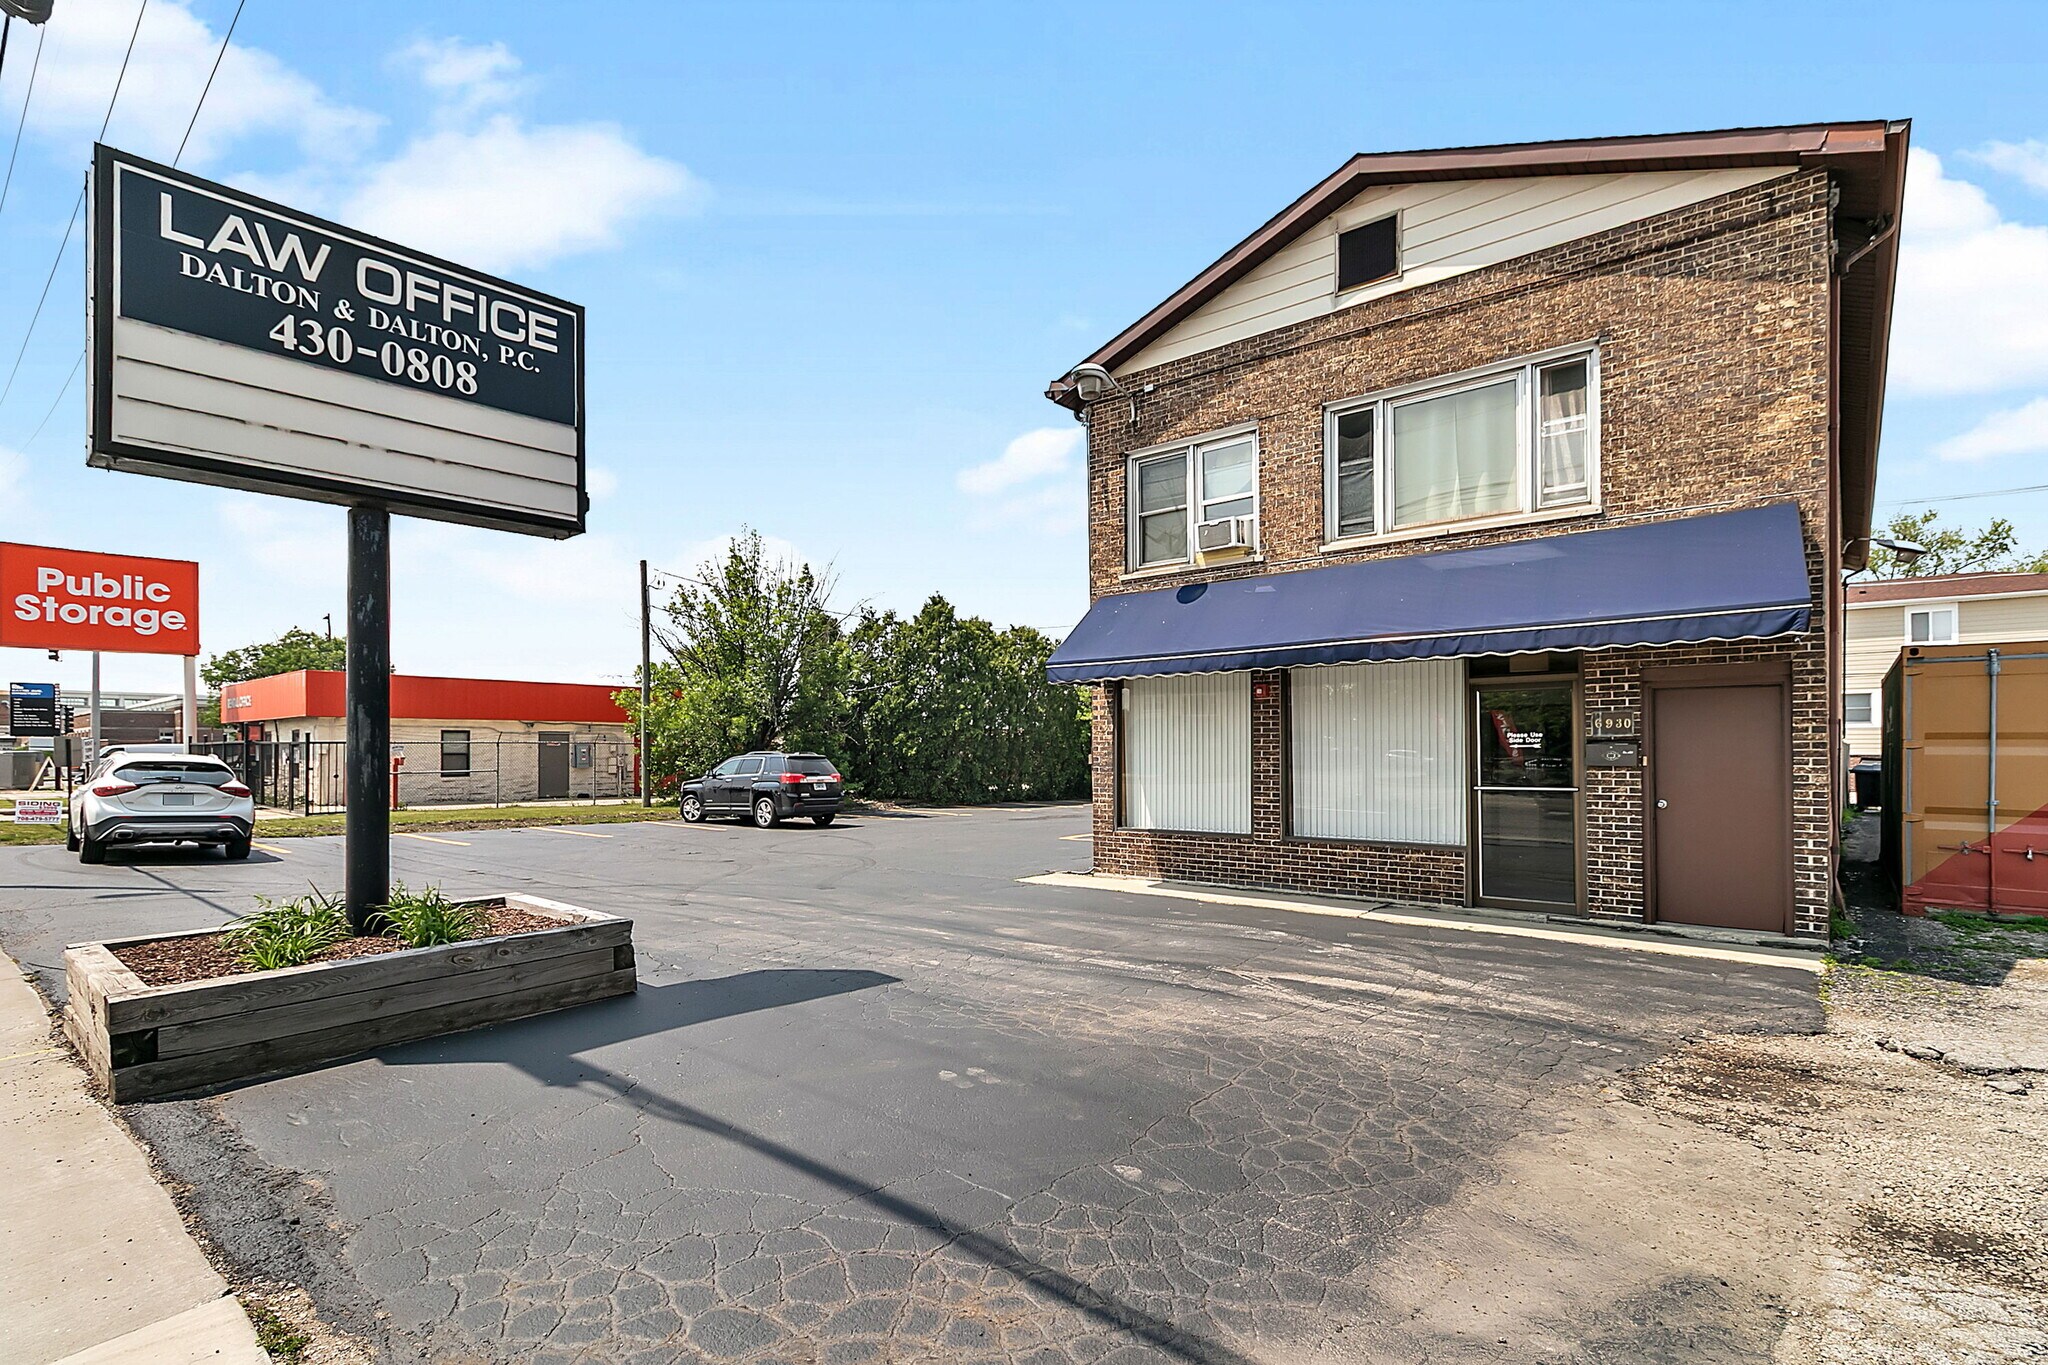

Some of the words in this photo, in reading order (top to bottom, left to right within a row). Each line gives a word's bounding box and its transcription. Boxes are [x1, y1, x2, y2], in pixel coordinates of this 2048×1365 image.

[160, 191, 332, 283] LAW
[356, 257, 558, 354] OFFICE
[179, 251, 321, 312] DALTON
[333, 299, 356, 322] &
[368, 306, 489, 363] DALTON,
[498, 344, 541, 373] P.C.
[268, 314, 478, 395] 430-0808
[37, 566, 171, 603] Public
[1594, 718, 1631, 729] 6930
